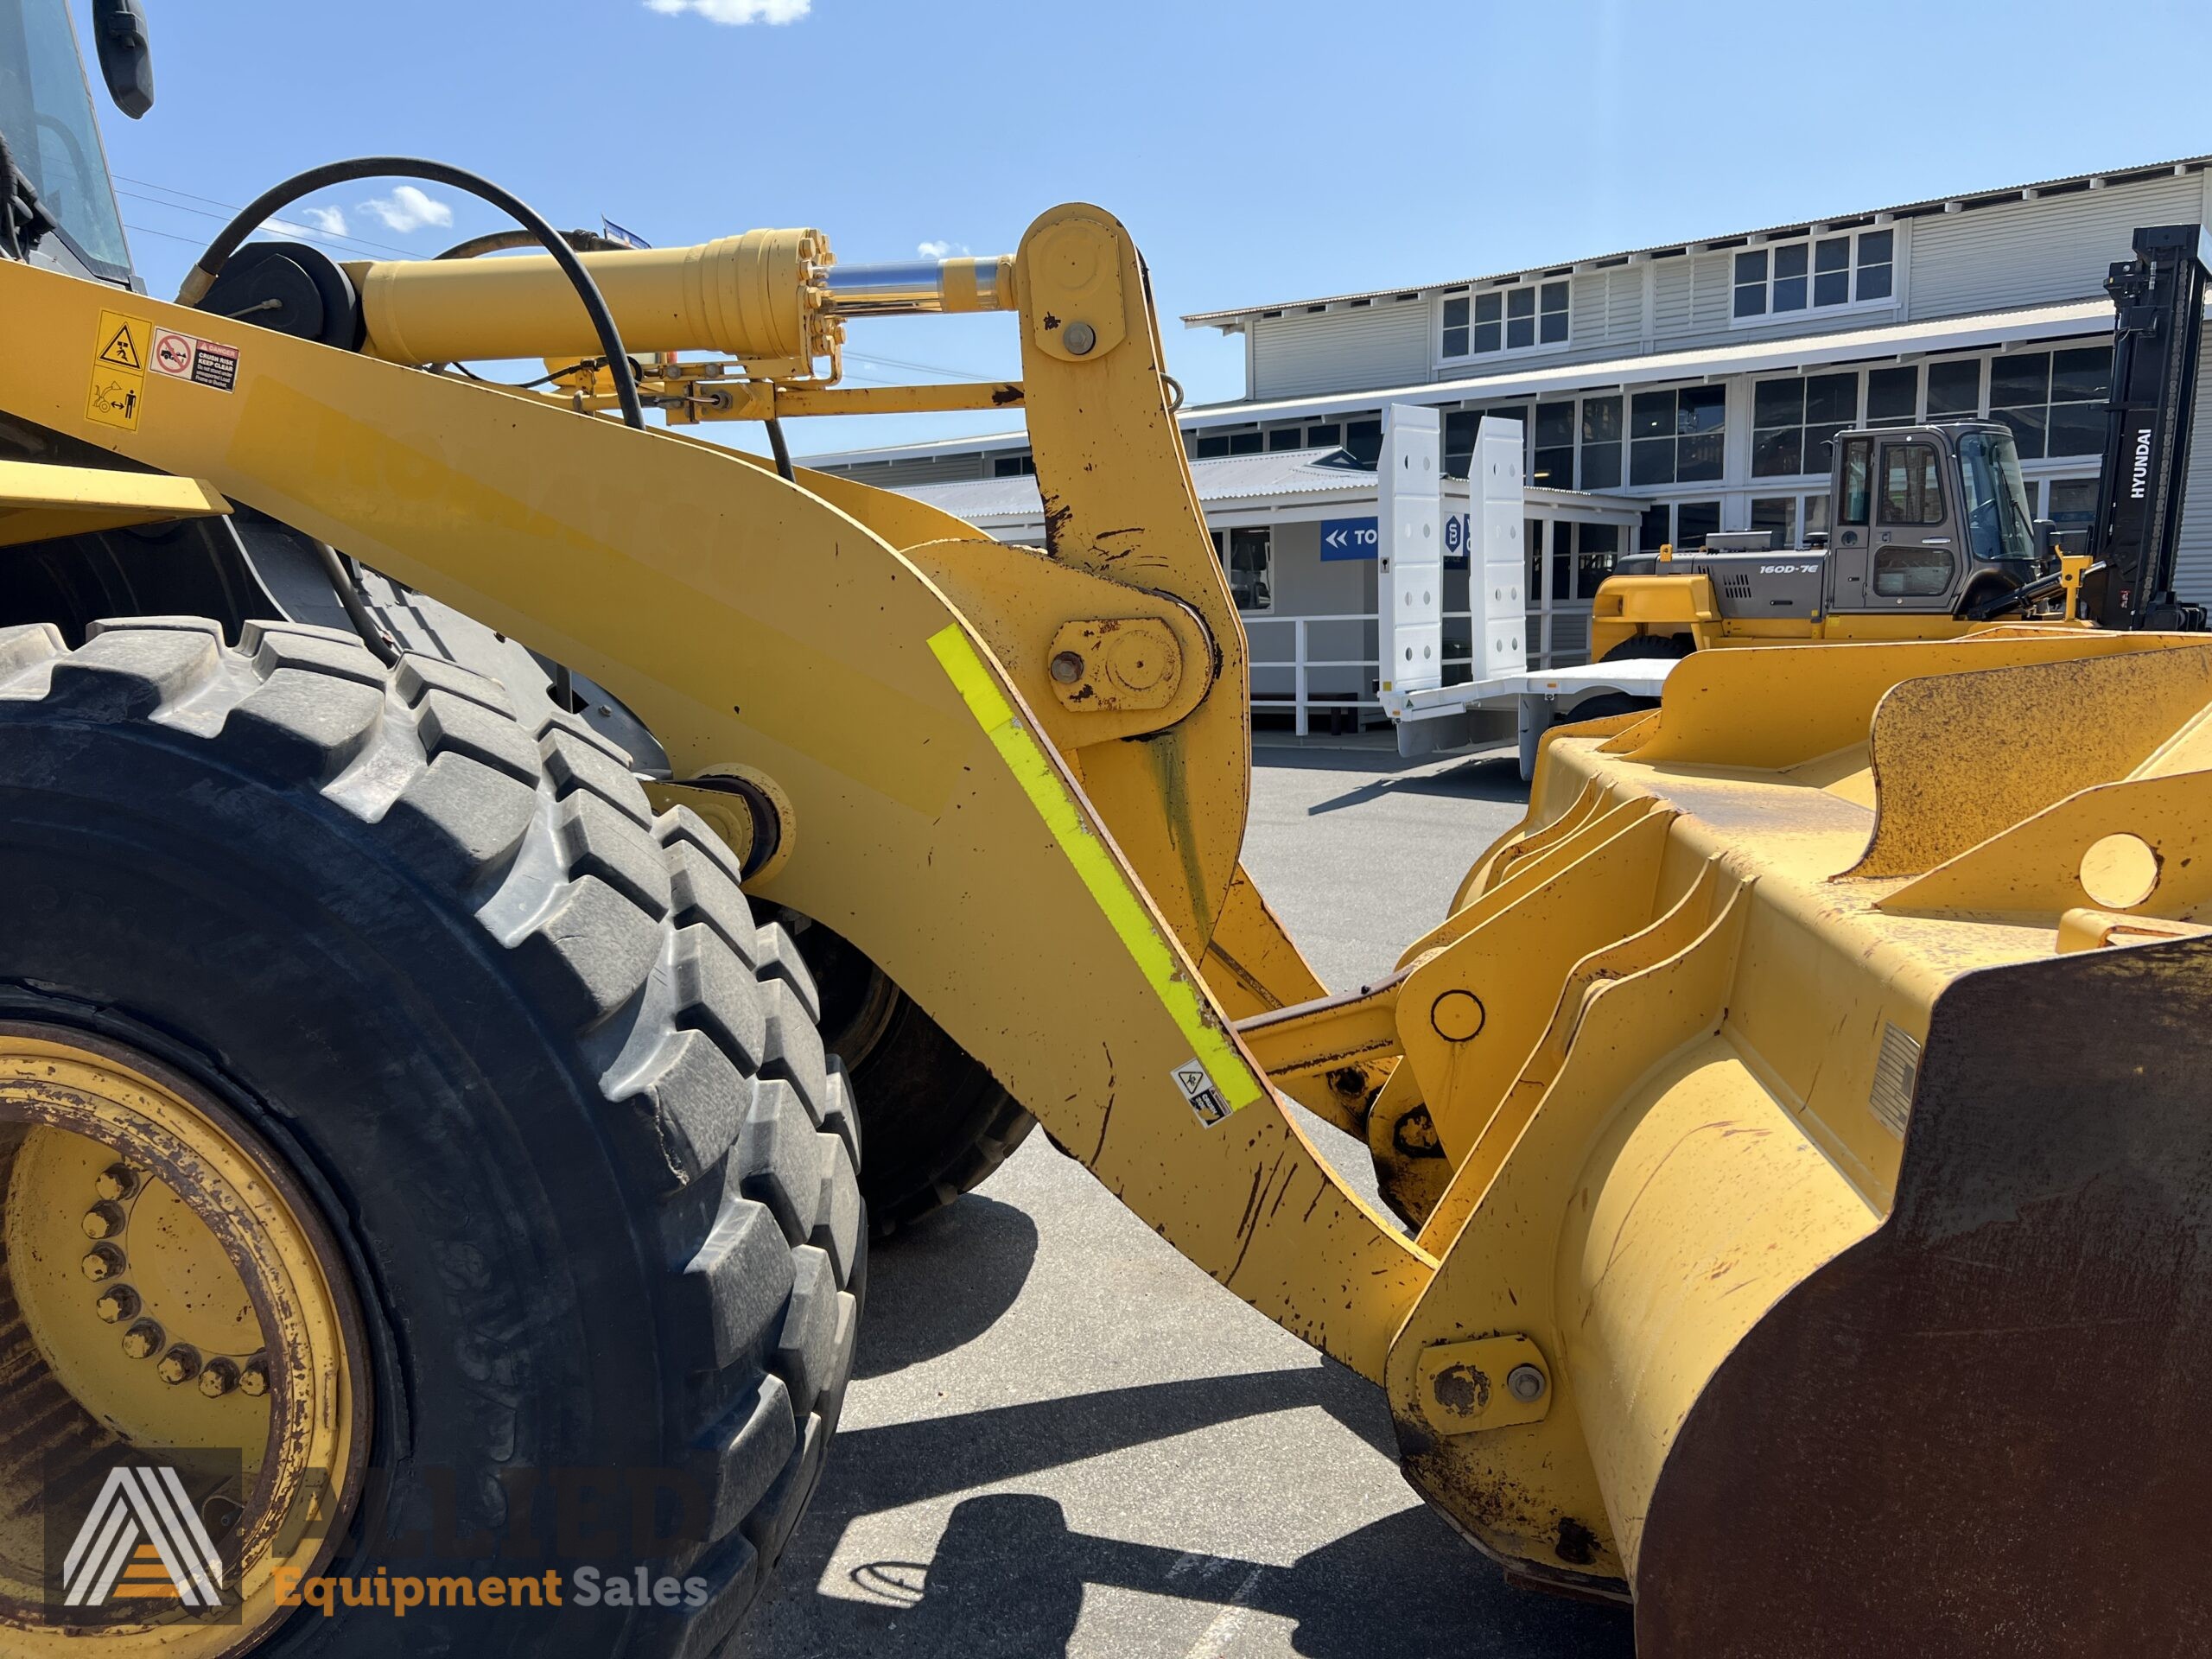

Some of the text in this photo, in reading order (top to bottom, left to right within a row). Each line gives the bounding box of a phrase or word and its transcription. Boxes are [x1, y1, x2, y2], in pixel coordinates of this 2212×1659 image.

[209, 346, 235, 357] DANGER
[199, 352, 219, 362] CRUSH
[214, 362, 233, 372] CLEAR
[2131, 429, 2152, 499] HYUNDAI
[1759, 564, 1819, 574] 160D-7E
[1202, 1093, 1217, 1115] CRUSH
